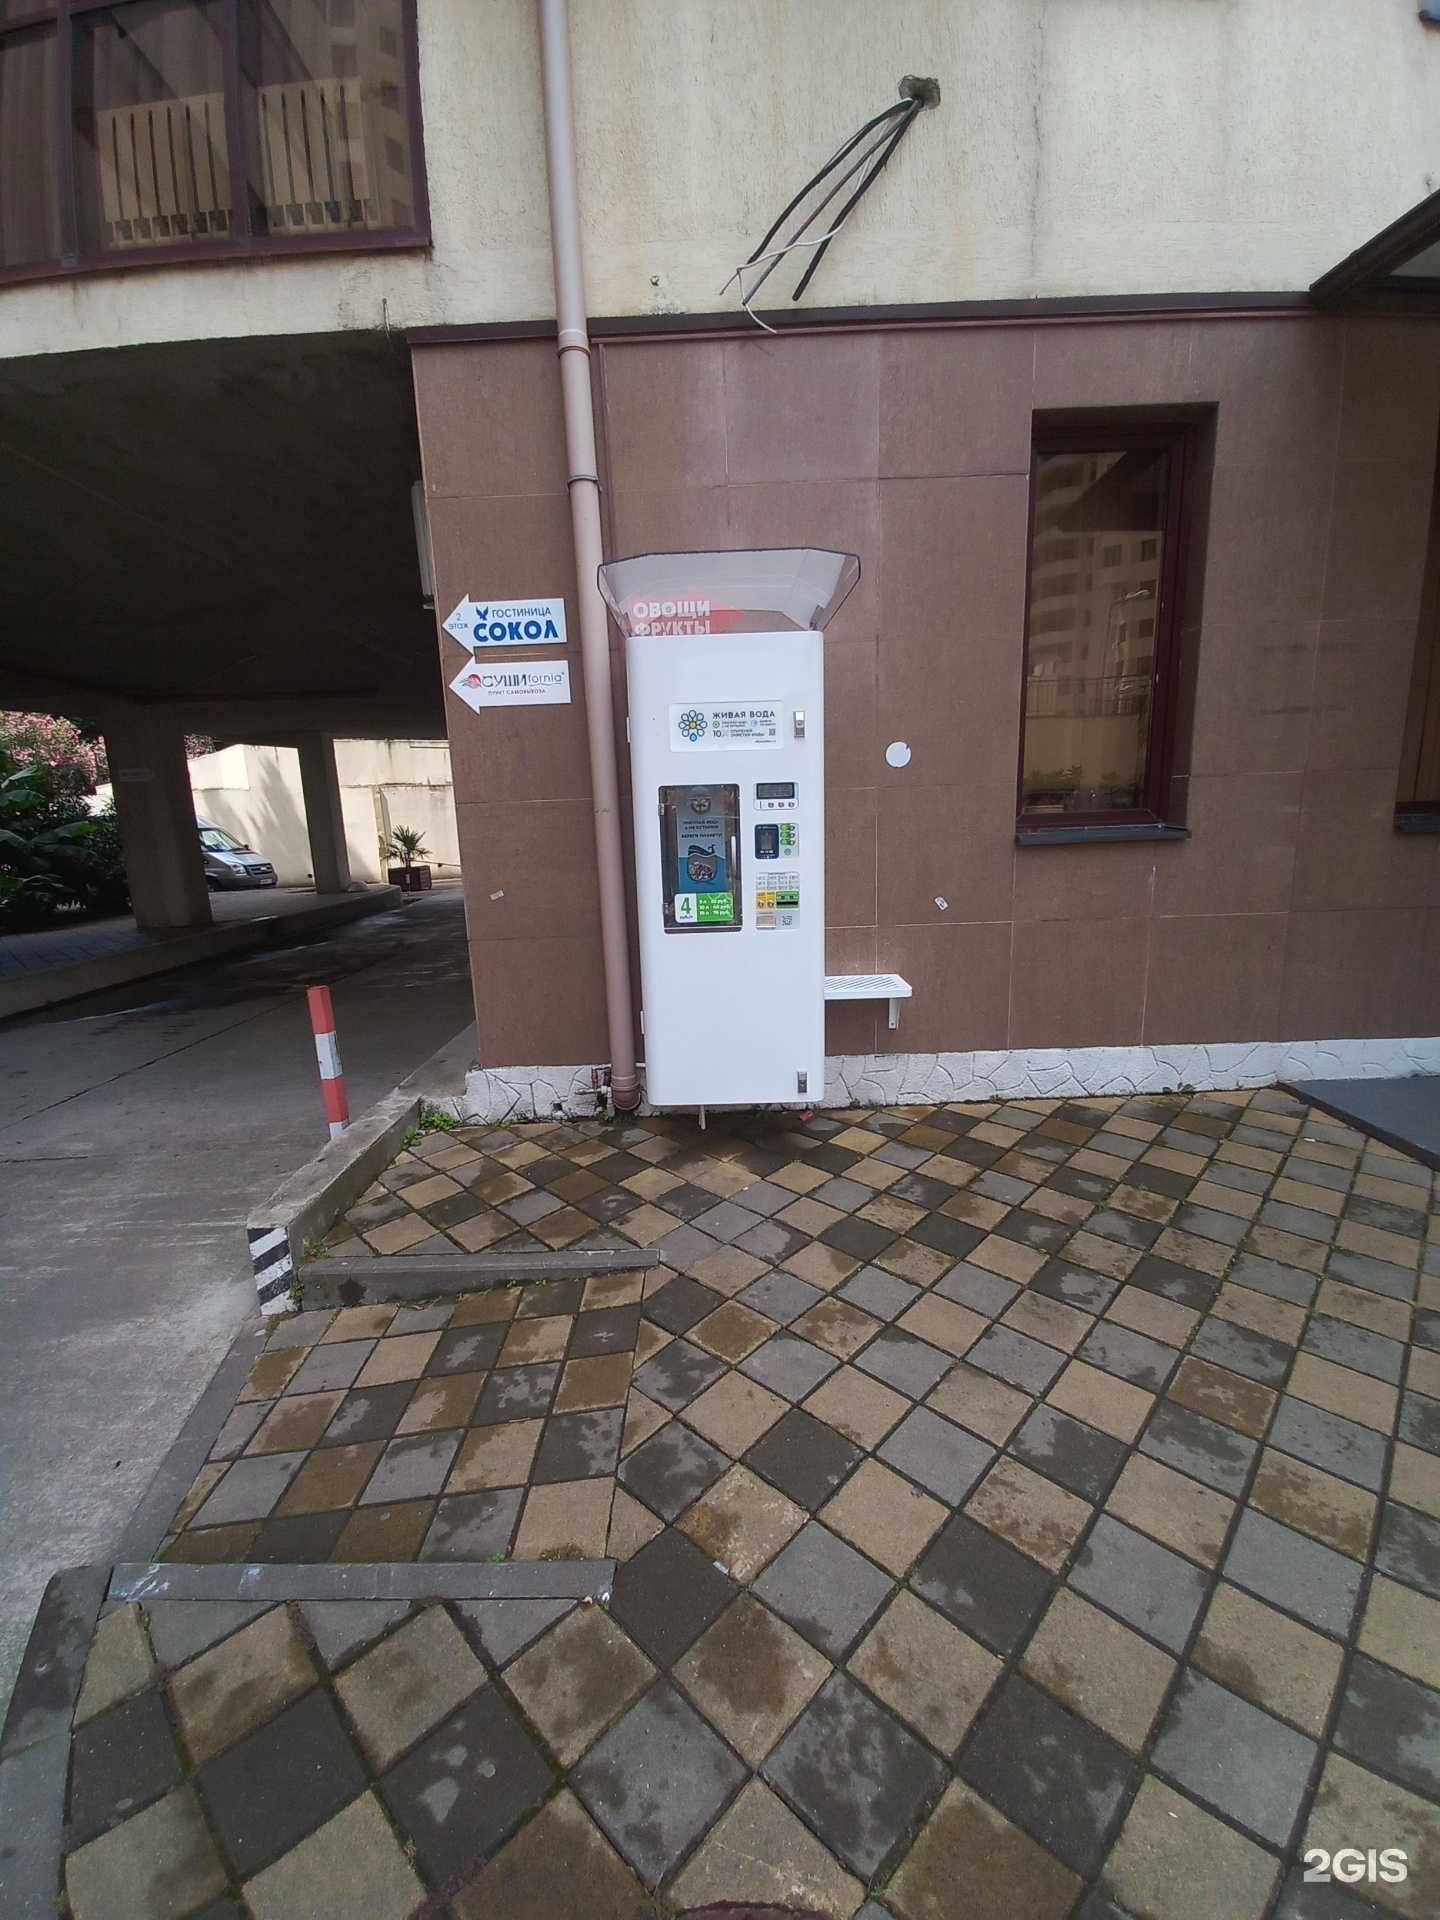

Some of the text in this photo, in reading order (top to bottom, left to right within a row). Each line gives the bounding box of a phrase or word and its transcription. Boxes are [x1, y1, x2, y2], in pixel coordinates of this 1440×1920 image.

[492, 607, 552, 618] ГОСТИНИЦА
[633, 600, 710, 619] ОВОЩИ
[473, 619, 559, 642] СОКОЛ
[634, 620, 710, 636] ФРУКТЫ
[712, 710, 775, 719] ЖИВАЯ ВОДА
[681, 896, 692, 914] 4
